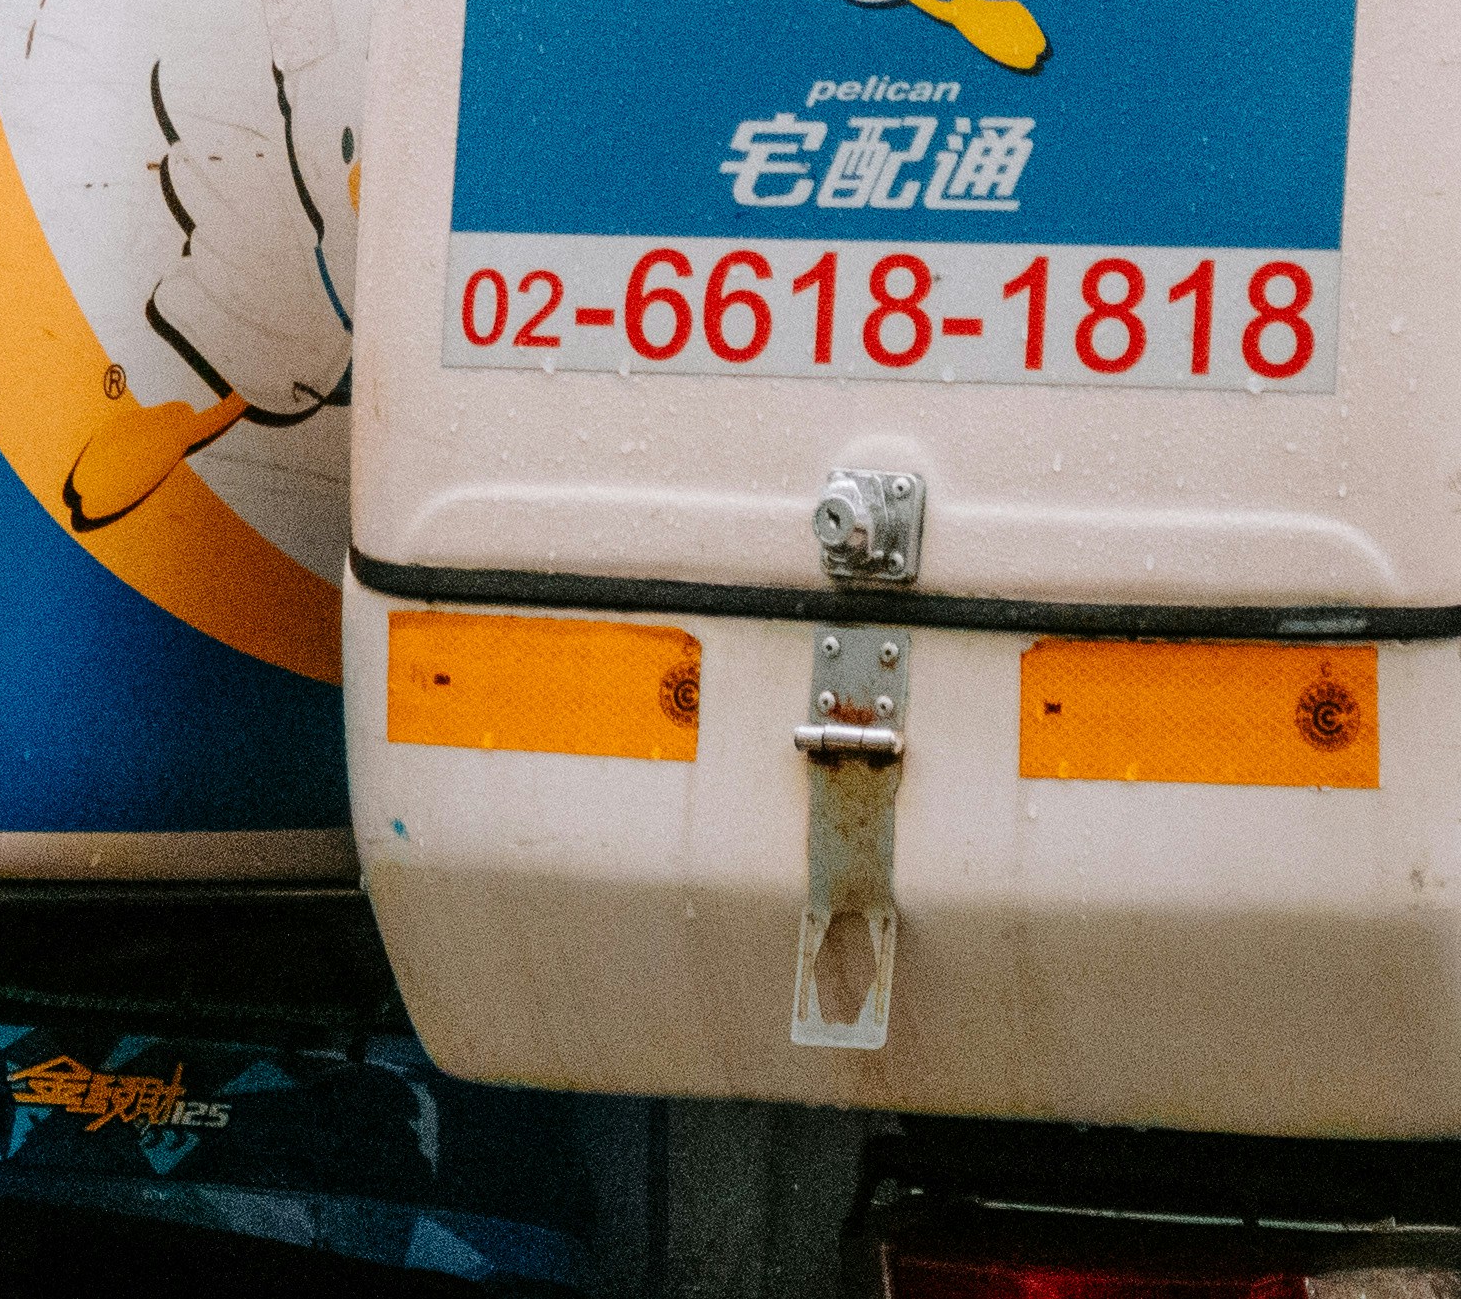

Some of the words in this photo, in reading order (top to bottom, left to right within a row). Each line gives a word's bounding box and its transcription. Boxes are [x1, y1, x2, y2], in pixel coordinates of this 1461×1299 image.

[806, 75, 963, 108] pelican
[719, 112, 1036, 212] 宅配通
[460, 247, 1316, 379] 02-6618-1818
